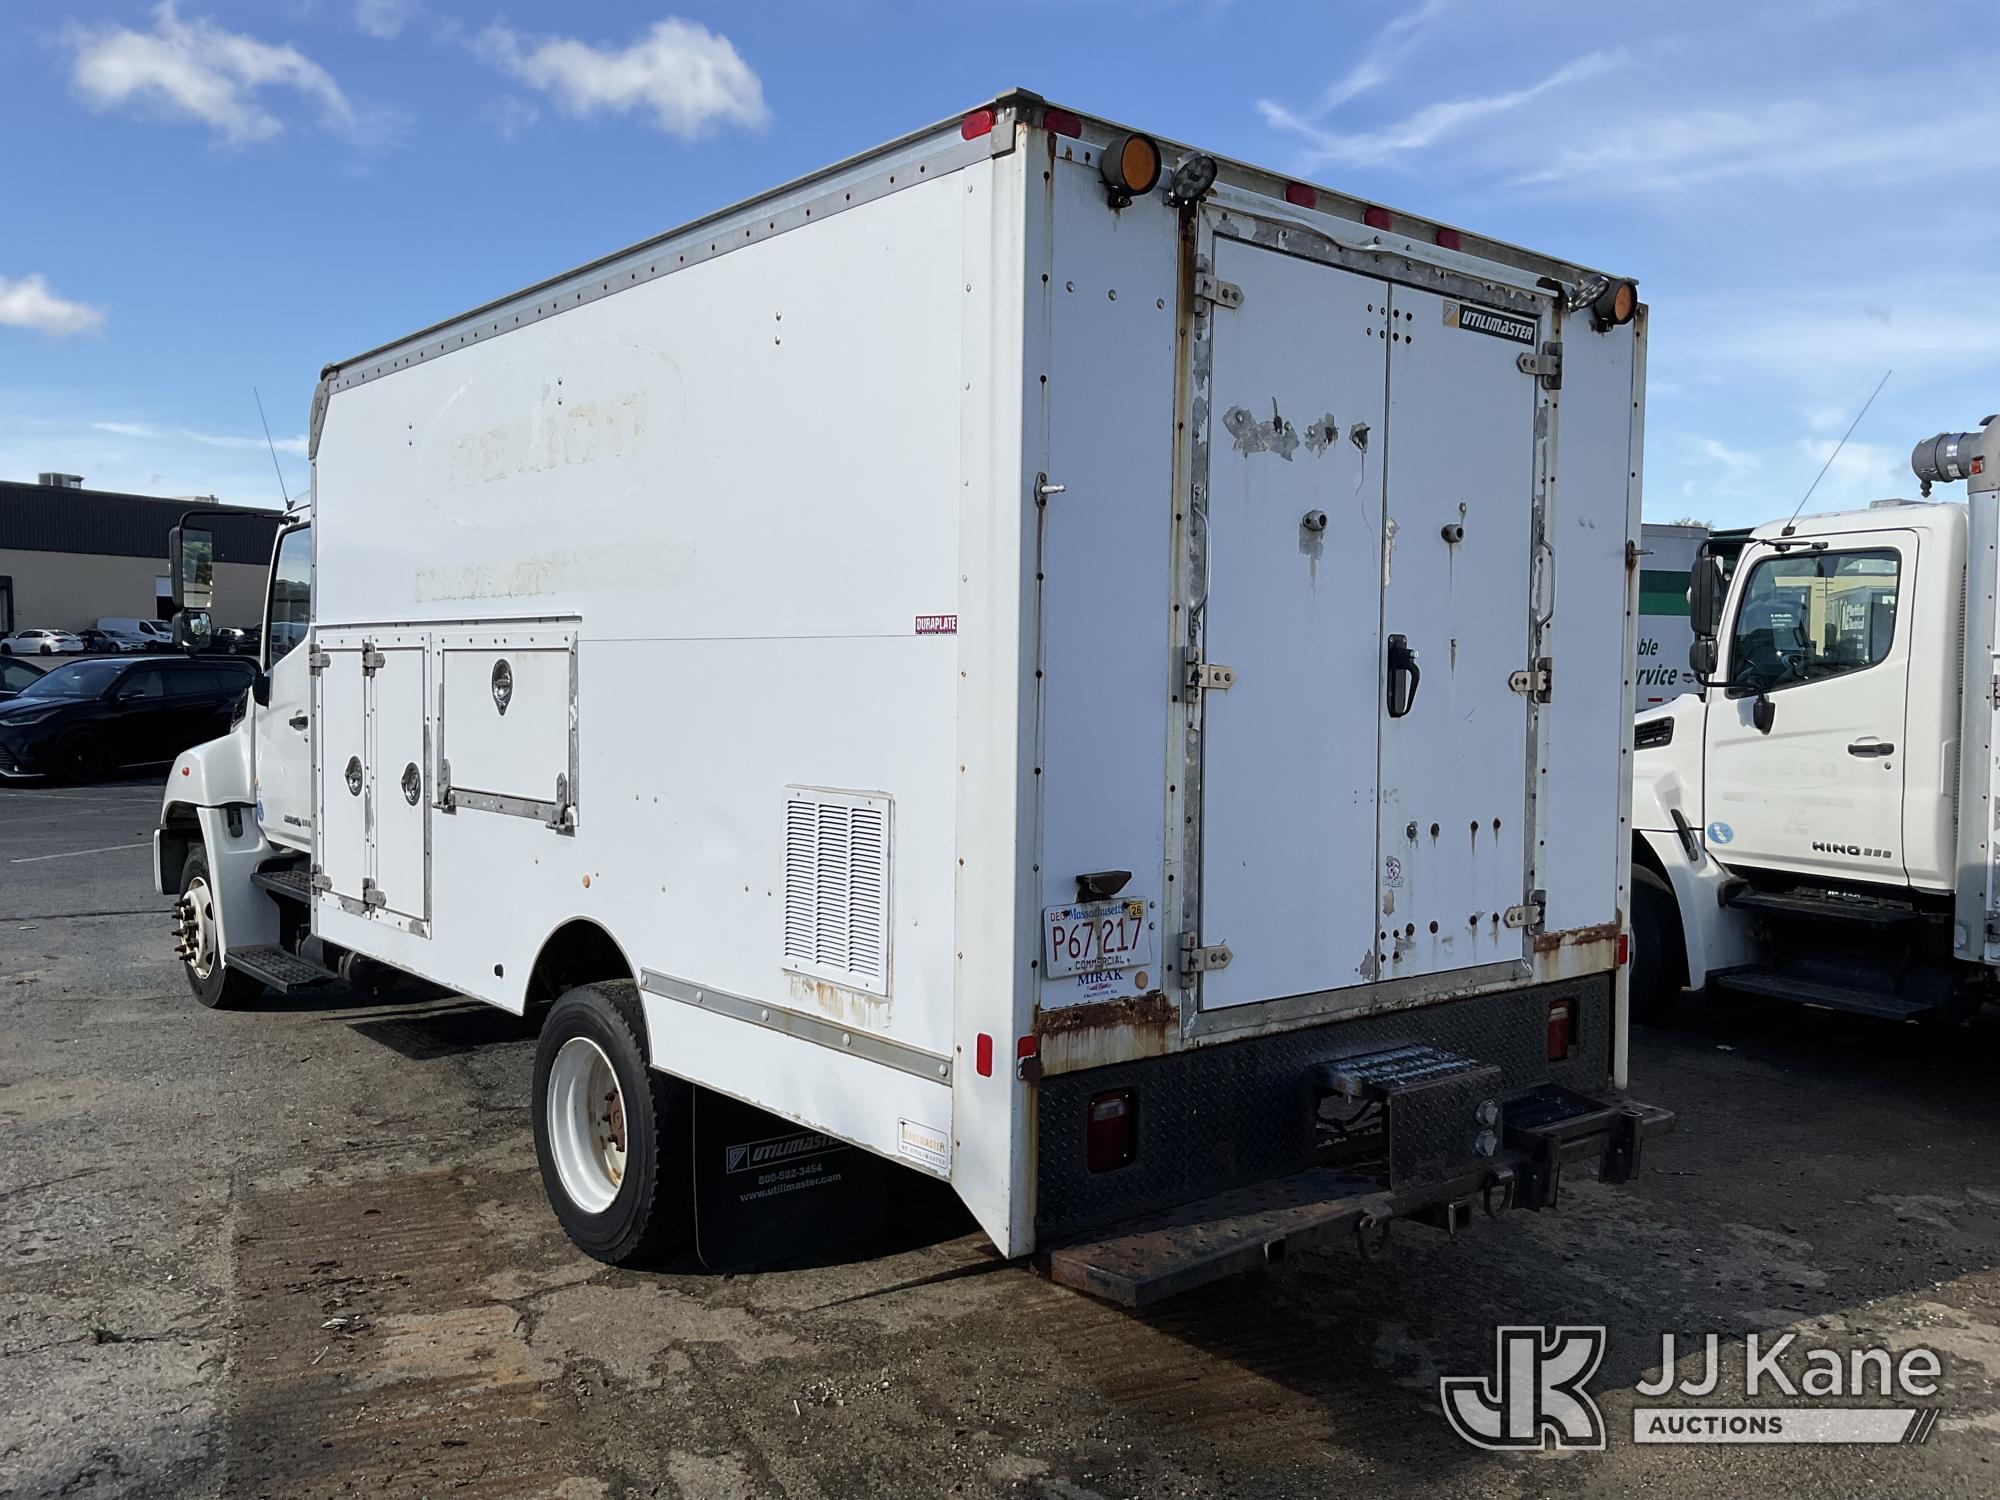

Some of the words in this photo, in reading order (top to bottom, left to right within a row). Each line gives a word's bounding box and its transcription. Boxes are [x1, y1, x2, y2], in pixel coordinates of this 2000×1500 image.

[916, 616, 956, 630] DURAPLATE
[1637, 639, 1658, 655] ble
[1636, 664, 1677, 685] rvice
[1813, 842, 1860, 856] HINO
[1131, 904, 1142, 915] 26
[1077, 968, 1124, 986] MIRAK
[739, 1173, 842, 1202] www.utilimaster.com
